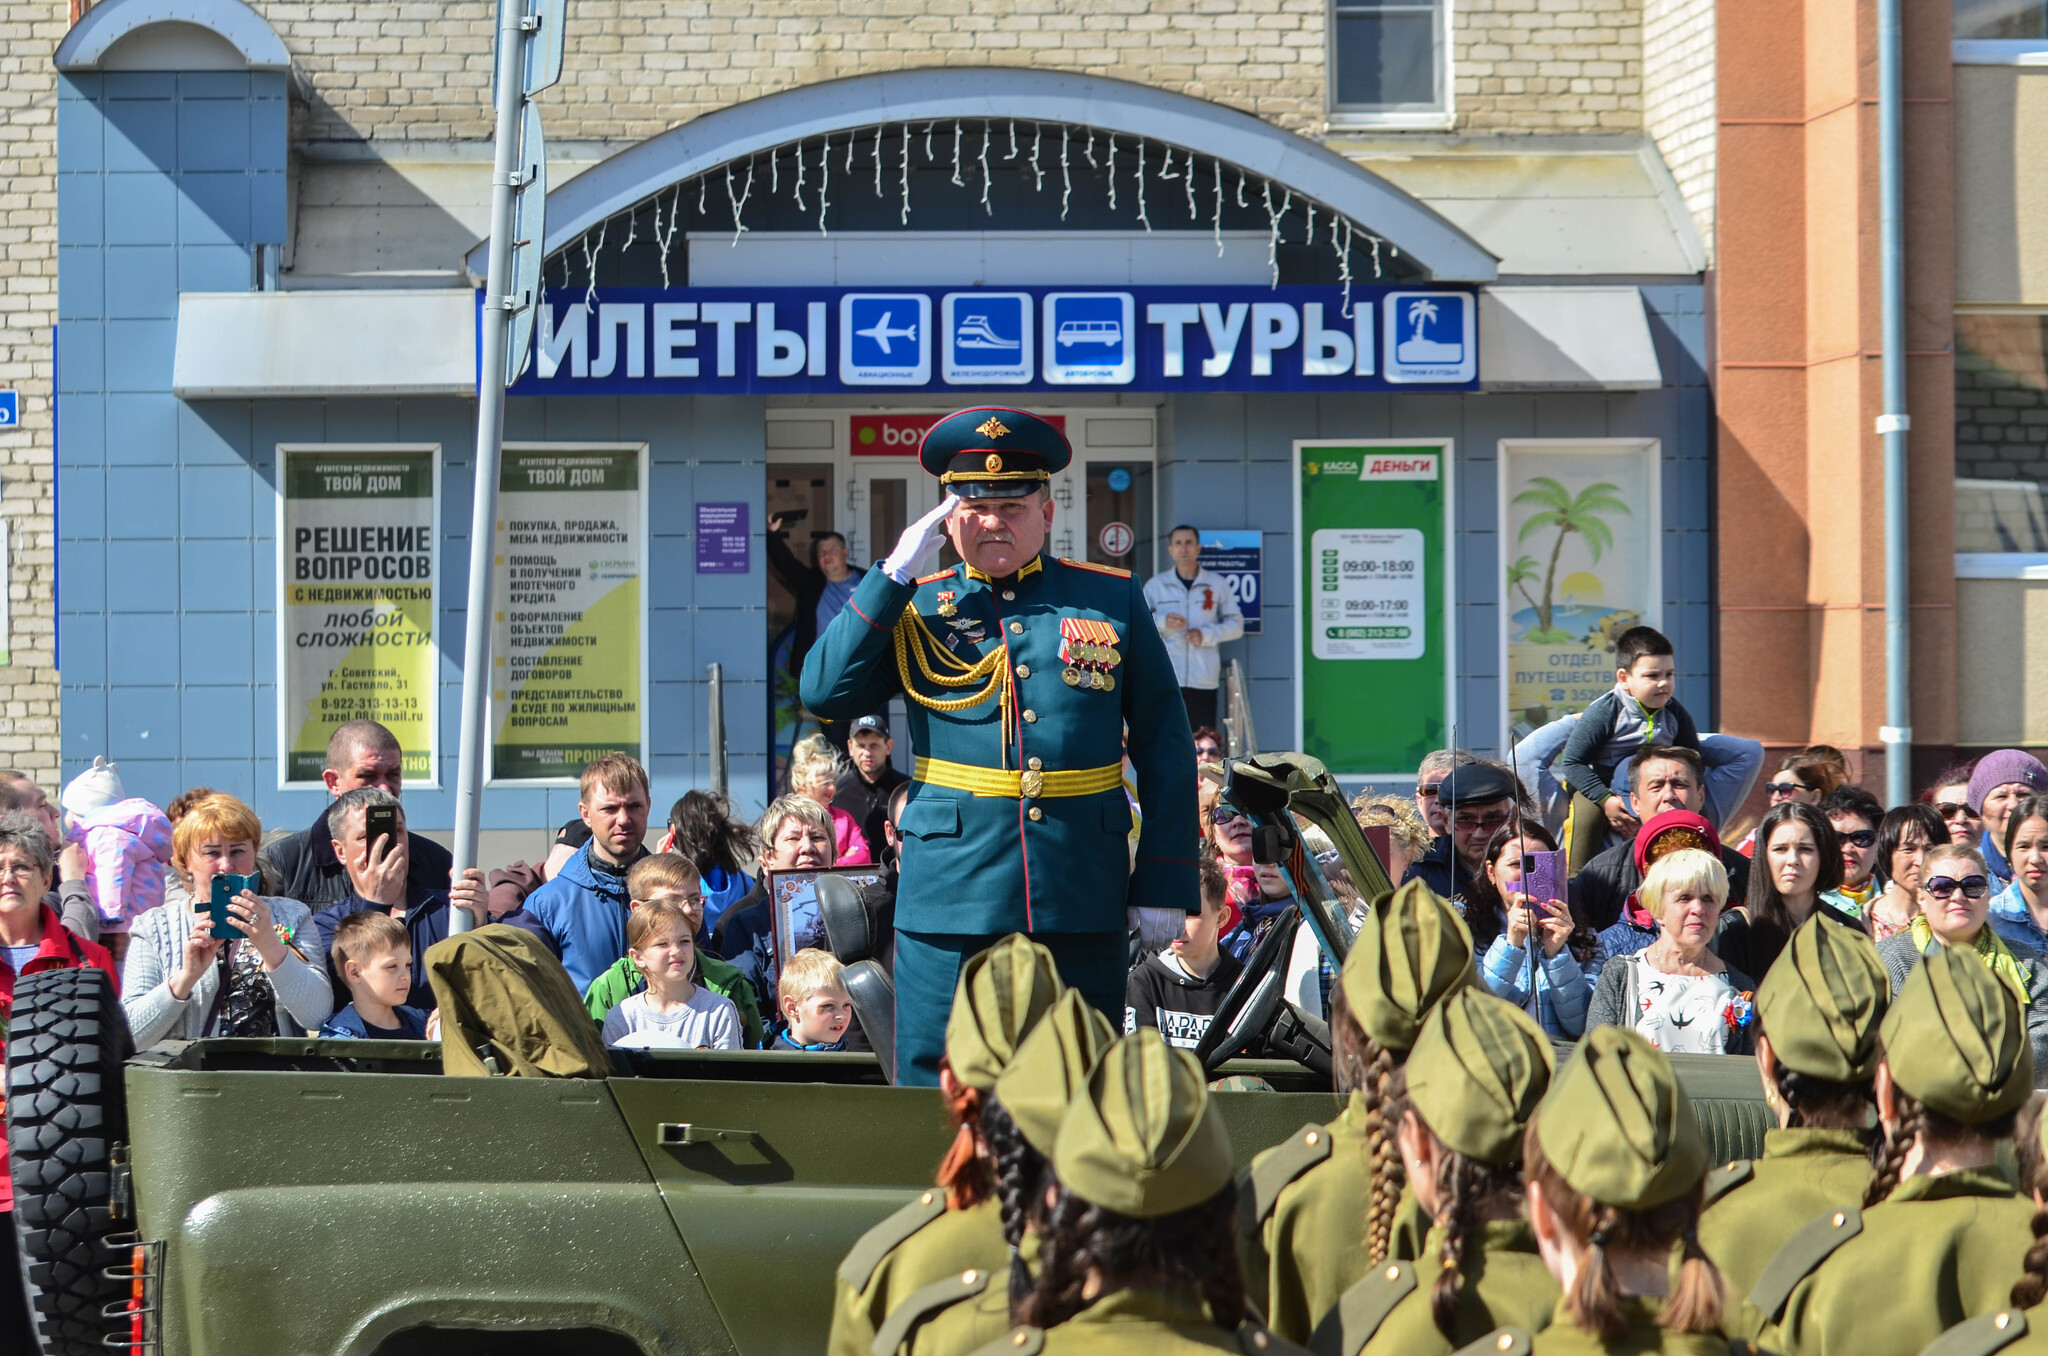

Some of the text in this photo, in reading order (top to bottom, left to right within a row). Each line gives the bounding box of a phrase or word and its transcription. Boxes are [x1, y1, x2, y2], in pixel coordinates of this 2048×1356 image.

[482, 302, 827, 378] ИЛЕТЫ
[1147, 302, 1375, 377] ТУРЫ
[519, 457, 613, 466] АГЕНТСТВО НЕДВИЖИМОСТИ
[1323, 460, 1431, 474] КАССА ДЕНЬГИ
[315, 465, 410, 473] АГЕНТСТВО НЕДВИЖИМОСТИ
[527, 467, 605, 486] ТВОЙ ДОМ
[324, 474, 402, 493] ТВОЙ ДОМ
[510, 520, 620, 532] ПОКУПКА, ПРОДАЖА,
[295, 526, 431, 553] РЕШЕНИЕ
[510, 533, 628, 545] МЕНА НЕДВИЖИМОСТИ
[510, 555, 557, 567] ПОМОЩЬ
[1343, 560, 1414, 572] 09:00-18:00
[295, 556, 431, 580] ВОПРОСОВ
[510, 567, 582, 578] В ПОЛУЧЕНИИ
[510, 580, 576, 591] ИПОТЕЧНОГО
[295, 587, 431, 602] С НЕДВИЖИМОСТЬЮ
[510, 593, 556, 604] КРЕДИТА
[1345, 600, 1408, 611] 09:00-17:00
[510, 611, 583, 622] ОФОРМЛЕНИЕ
[510, 624, 564, 635] ОБЪЕКТОВ
[510, 636, 597, 648] НЕДВИЖИМОСТИ
[511, 655, 583, 666] СОСТАВЛЕНИЕ
[1549, 653, 1603, 667] ОТДЕЛ
[342, 667, 401, 679] Советский,
[511, 669, 572, 681] ДОГОВОРОВ
[321, 679, 408, 692] ул. Гастелло, 31
[511, 689, 623, 701] ПРЕДСТАВИТЕЛЬСТВО
[321, 698, 418, 709] 8-922-313-13-13
[511, 702, 636, 714] В СУДЕ ПО ЖИЛИЩНЫМ
[511, 716, 568, 727] ВОПРОСАМ
